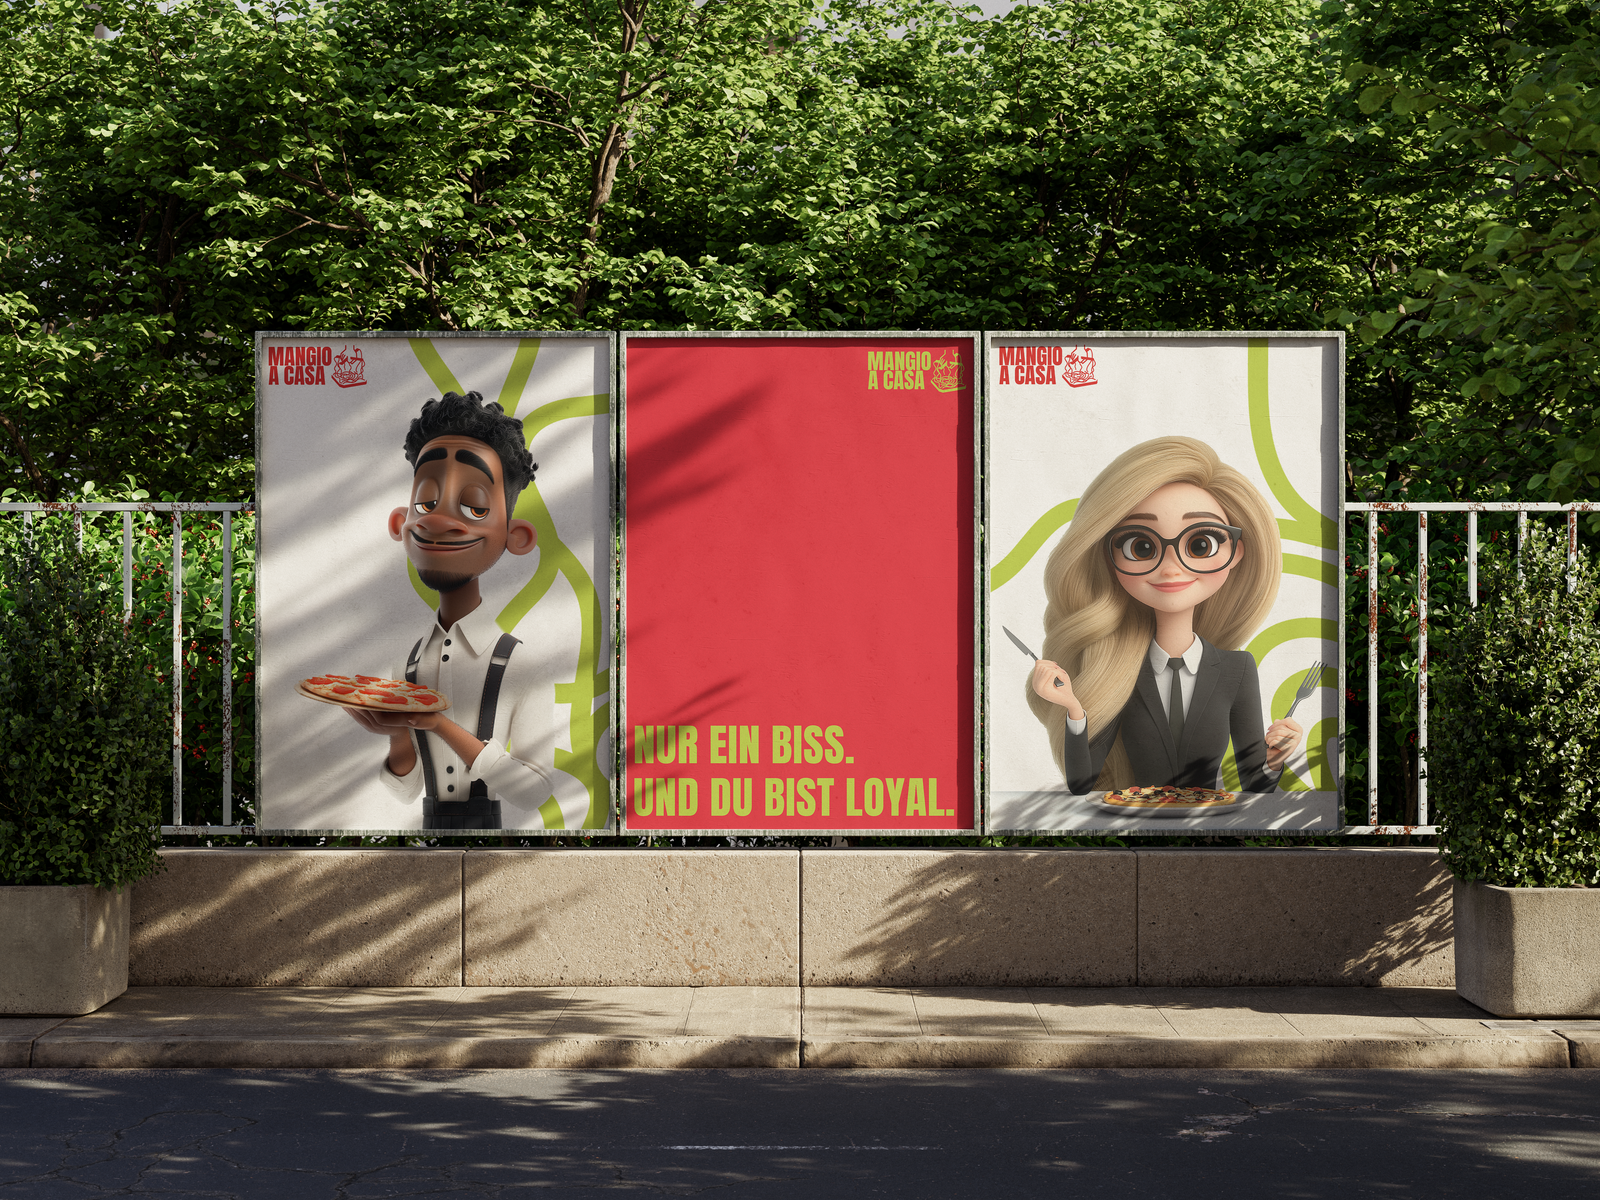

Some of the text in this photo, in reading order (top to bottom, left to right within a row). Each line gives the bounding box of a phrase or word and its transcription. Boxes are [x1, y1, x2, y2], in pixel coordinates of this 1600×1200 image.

[268, 346, 332, 366] MANGIO
[868, 351, 931, 371] MANGIO
[999, 346, 1063, 366] MANGIO
[268, 366, 326, 385] A CASA
[868, 370, 925, 390] A CASA
[999, 365, 1056, 385] A CASA
[634, 725, 854, 763] NUR EIN BISS.
[634, 778, 955, 816] UND DU BIST LOYAL.
